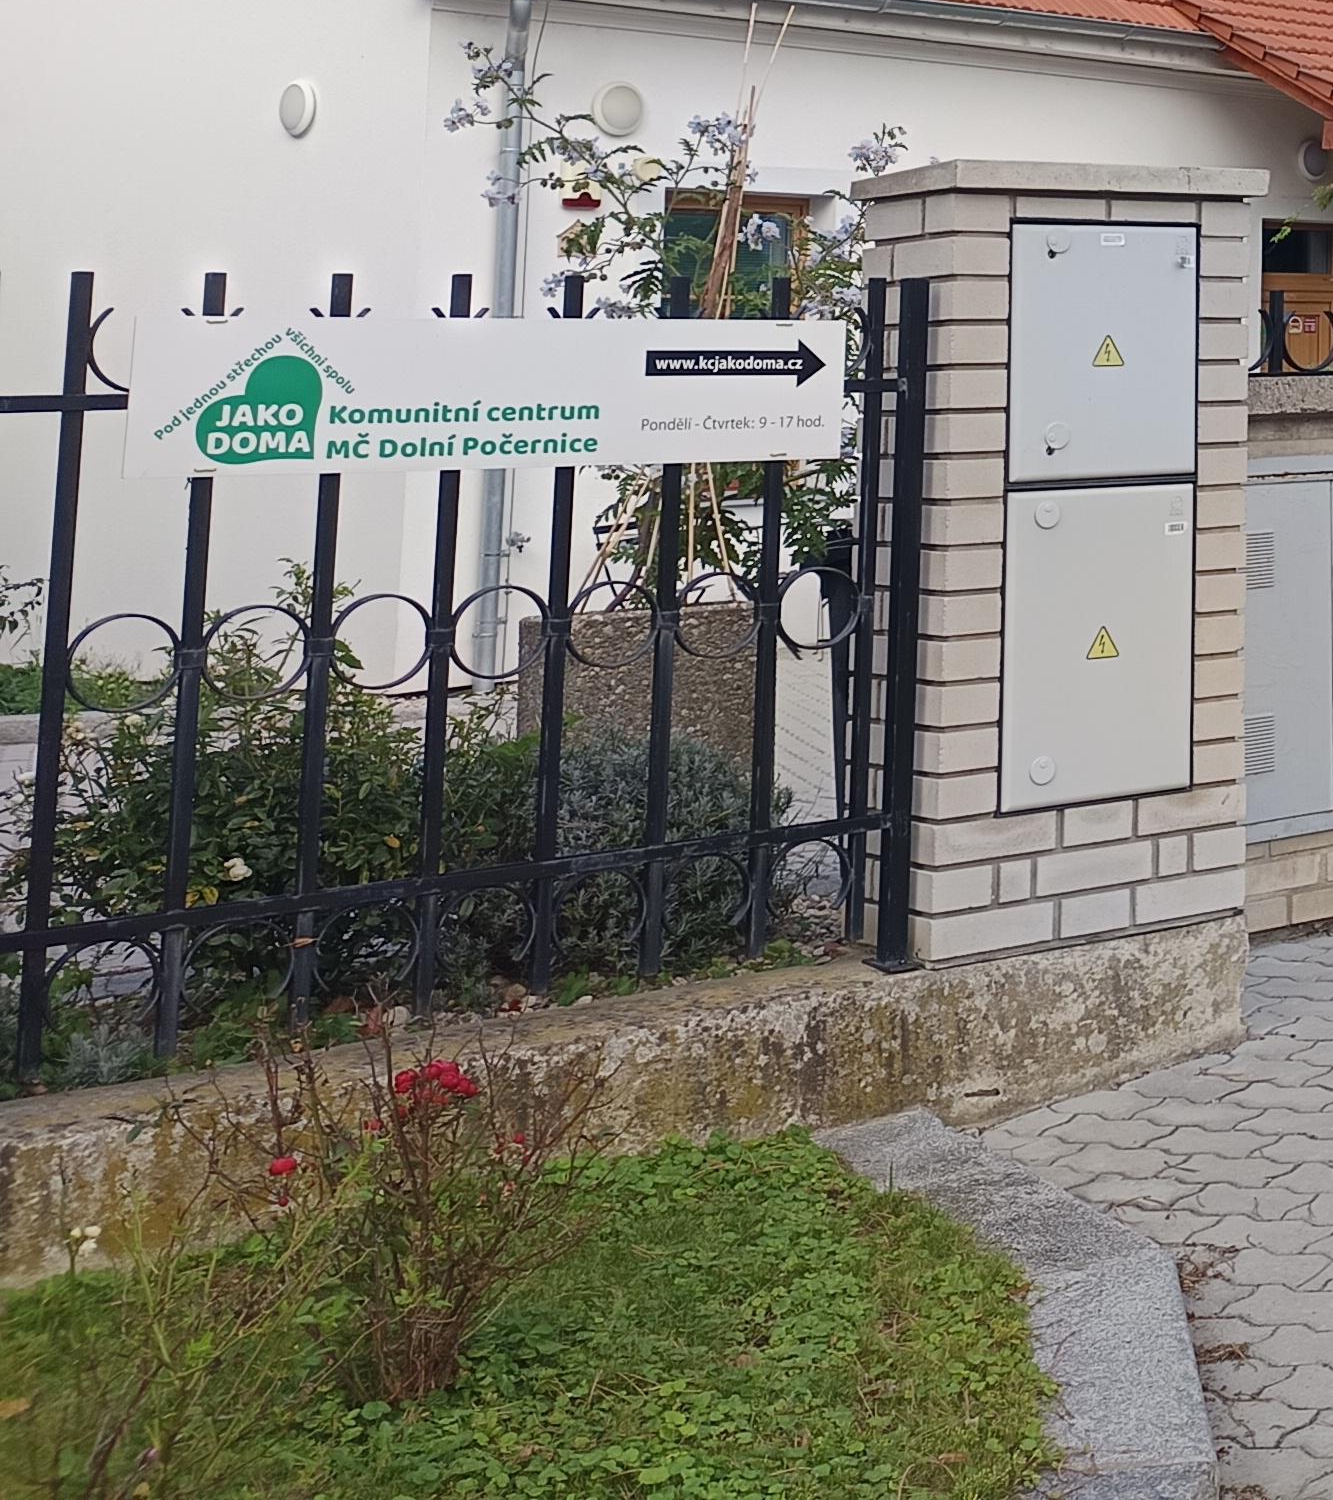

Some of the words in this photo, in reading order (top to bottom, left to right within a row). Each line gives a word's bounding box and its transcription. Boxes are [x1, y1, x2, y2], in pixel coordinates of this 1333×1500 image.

[655, 355, 803, 372] www.kcjakodoma.cz
[154, 415, 182, 441] Pod
[179, 379, 227, 422] jednou
[226, 333, 283, 382] střechou
[285, 327, 328, 367] všichni
[323, 364, 355, 395] spolu
[215, 403, 304, 427] JAKO
[329, 400, 481, 425] Komunitní
[487, 403, 600, 423] centrum
[641, 416, 692, 431] Pondělí
[702, 414, 755, 430] Čtvrtek:
[759, 416, 767, 429] 9
[779, 416, 794, 428] 17
[797, 415, 825, 428] hod.
[207, 431, 310, 455] DOMA
[326, 432, 369, 459] MČ
[379, 434, 456, 458] Dolní
[462, 432, 598, 456] Počernice
